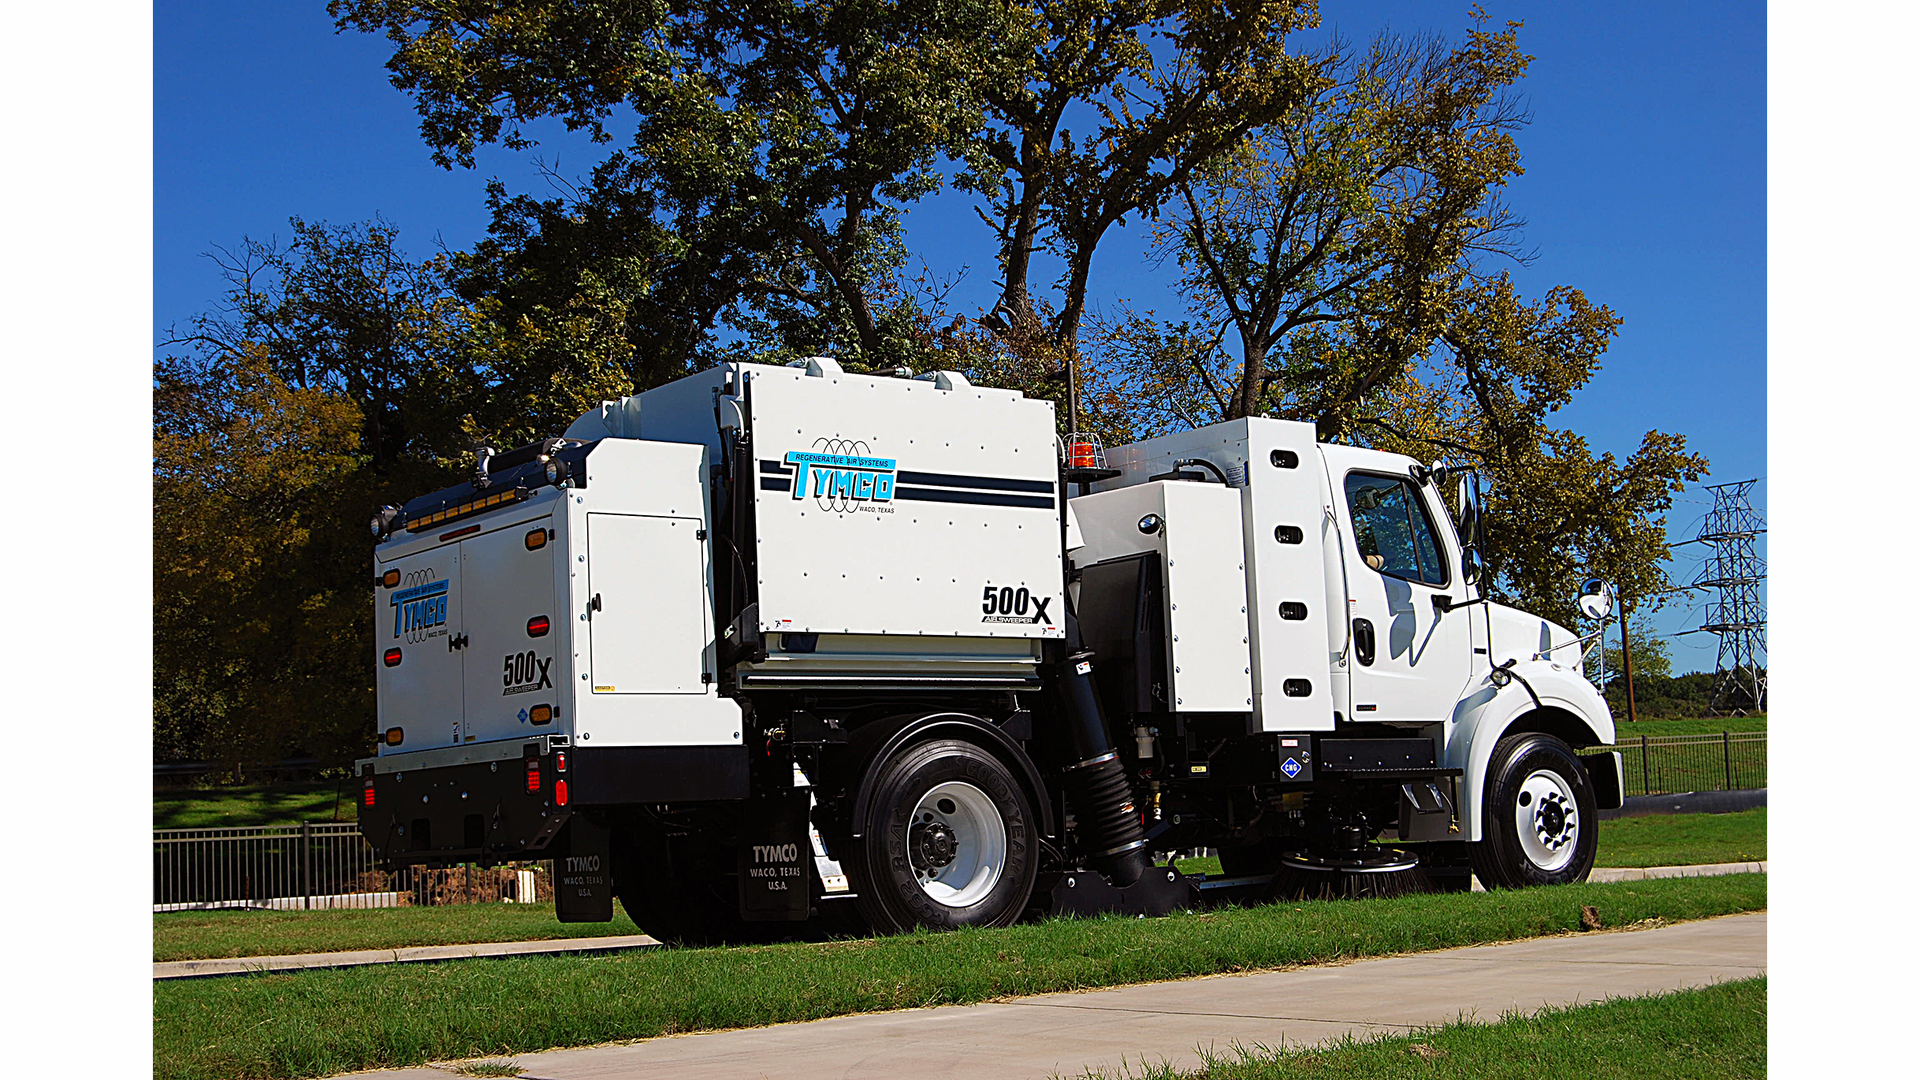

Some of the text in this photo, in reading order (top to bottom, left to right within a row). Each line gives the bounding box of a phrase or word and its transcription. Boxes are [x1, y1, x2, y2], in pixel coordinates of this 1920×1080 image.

[796, 454, 843, 464] REGENERATIVE
[860, 458, 889, 468] SYSTEMS
[784, 451, 896, 502] TYMCO
[859, 506, 876, 514] WACO,
[390, 579, 449, 639] TYMCO
[1284, 764, 1298, 772] CNG
[965, 760, 1026, 877] GOODYEAR
[752, 843, 798, 863] TYMCO
[566, 854, 601, 873] TYMCO
[563, 876, 604, 885] WACO, TEXAS
[750, 867, 800, 878] WACO, TEXAS
